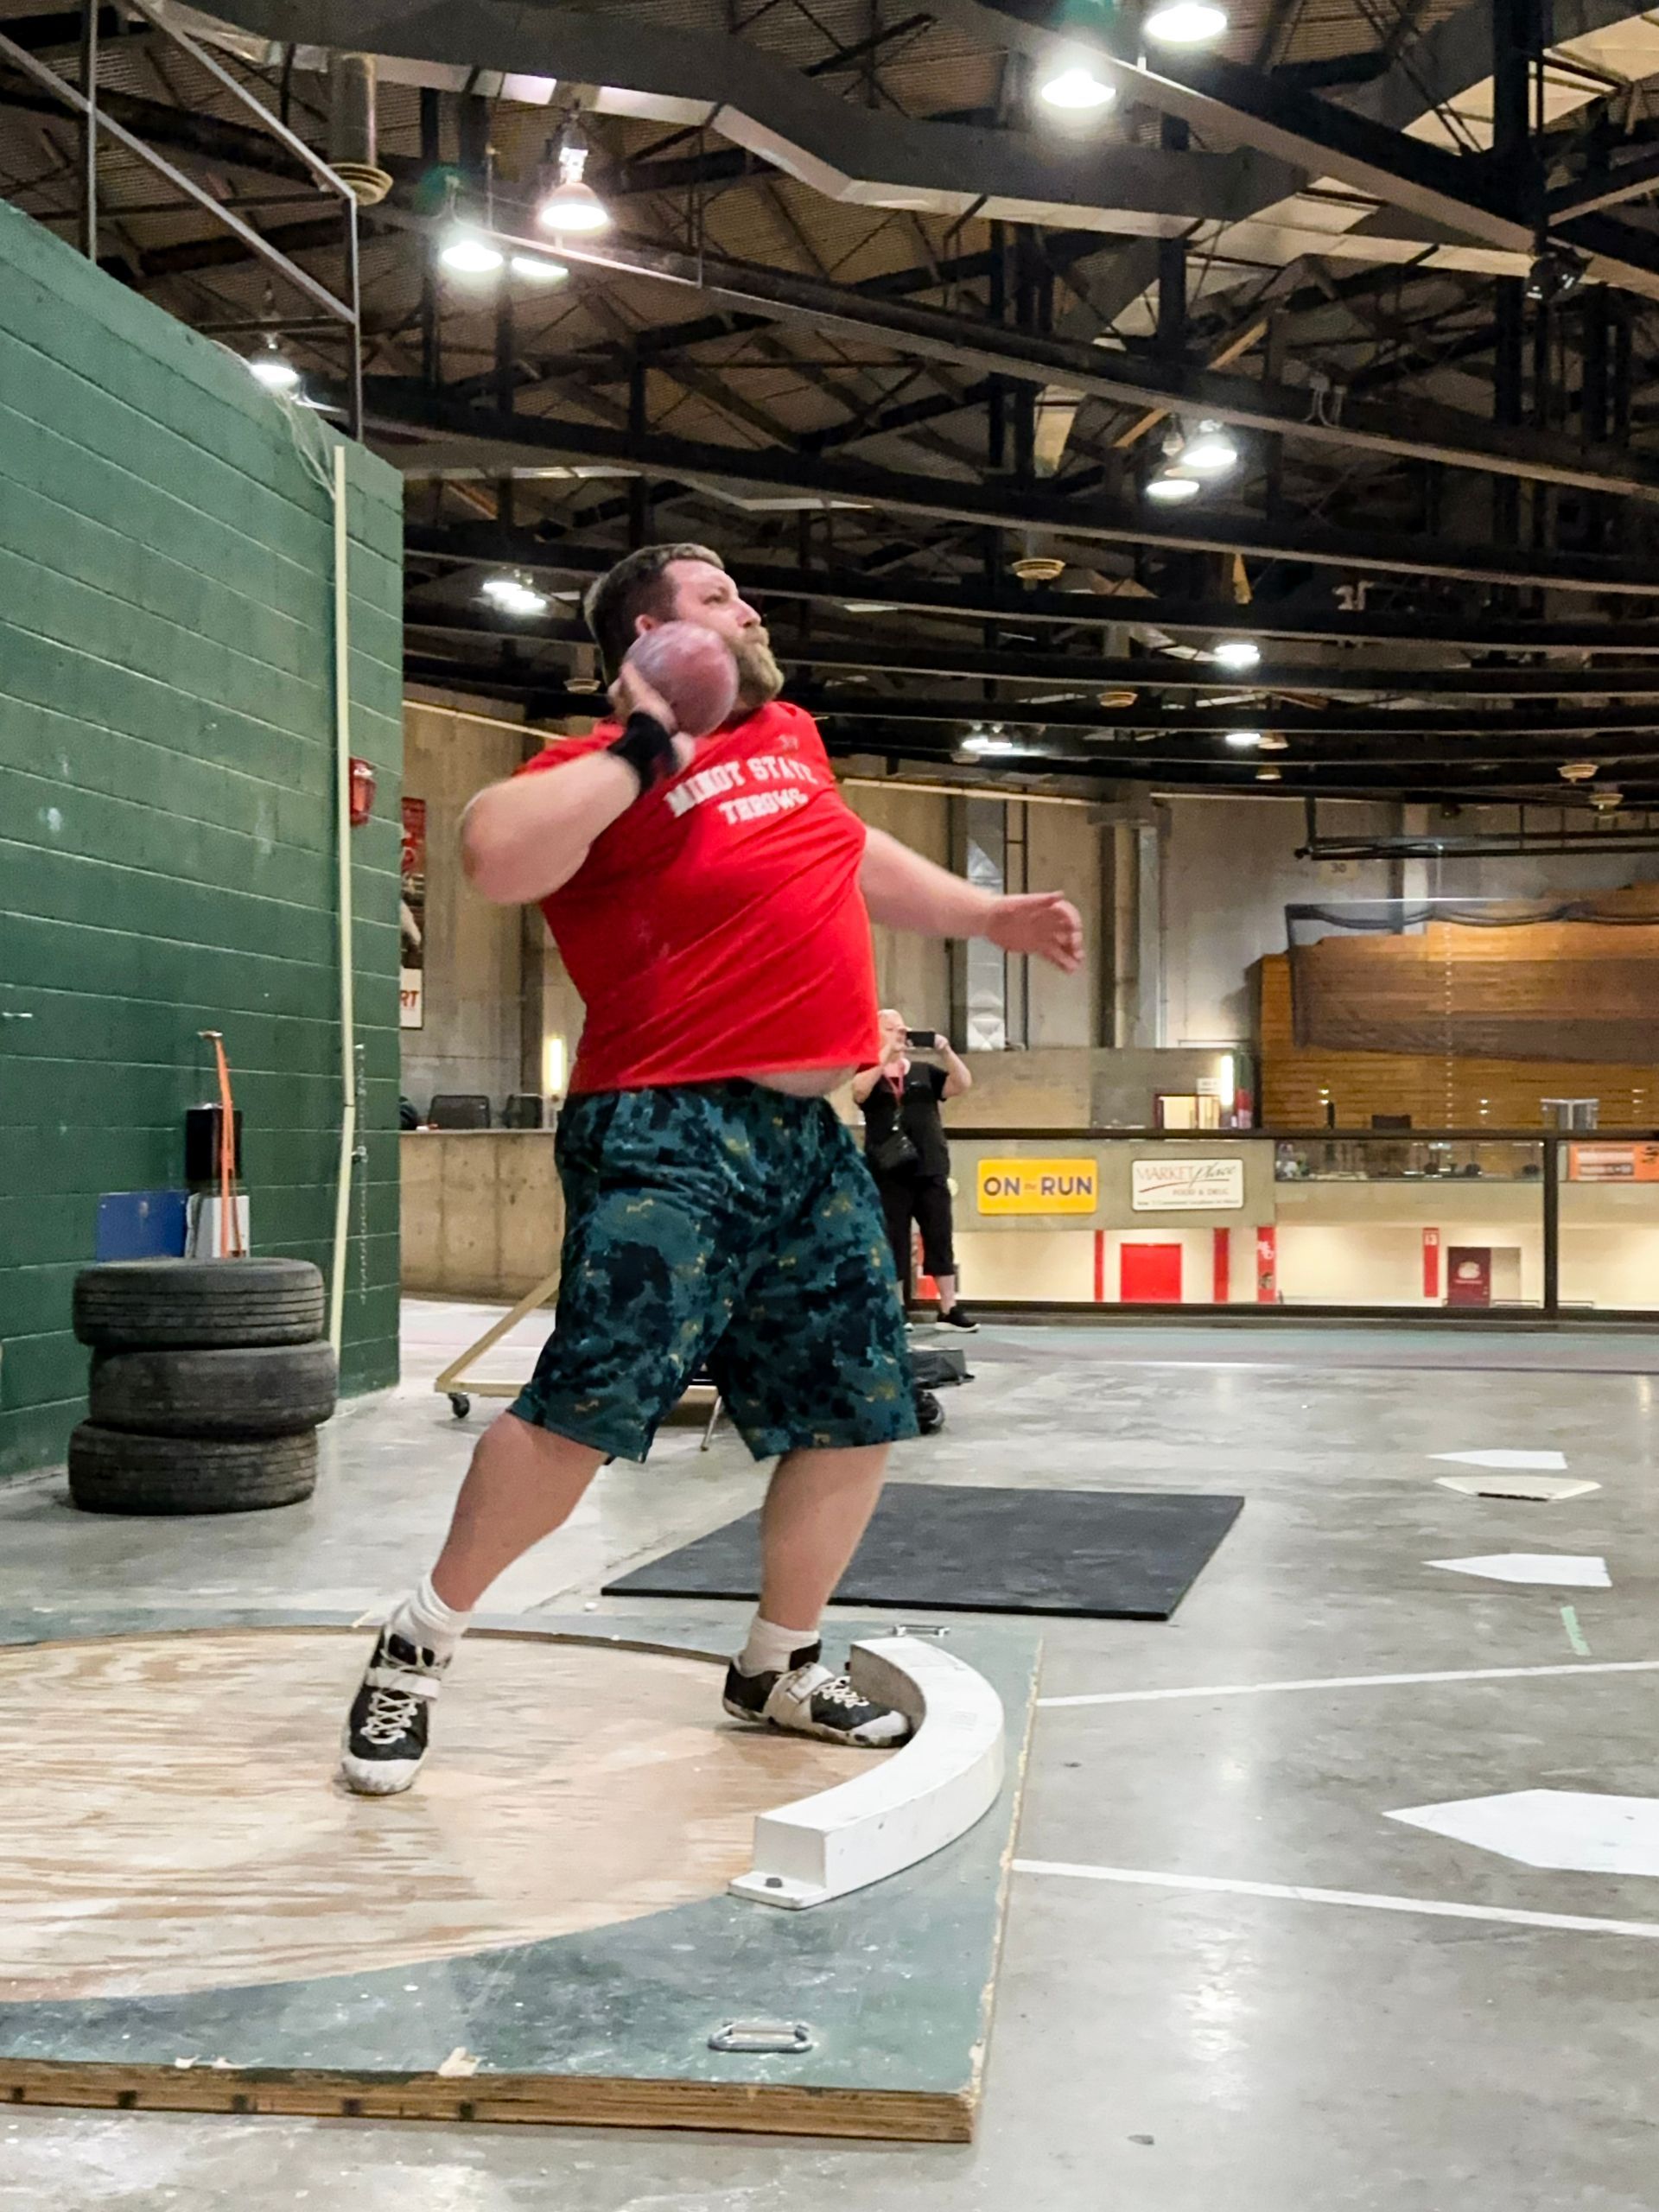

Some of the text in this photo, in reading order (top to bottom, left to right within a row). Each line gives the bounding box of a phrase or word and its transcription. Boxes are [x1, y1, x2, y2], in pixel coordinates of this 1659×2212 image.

[664, 760, 746, 818] MINOT
[983, 1176, 1020, 1197] ON
[1040, 1176, 1092, 1196] RUN
